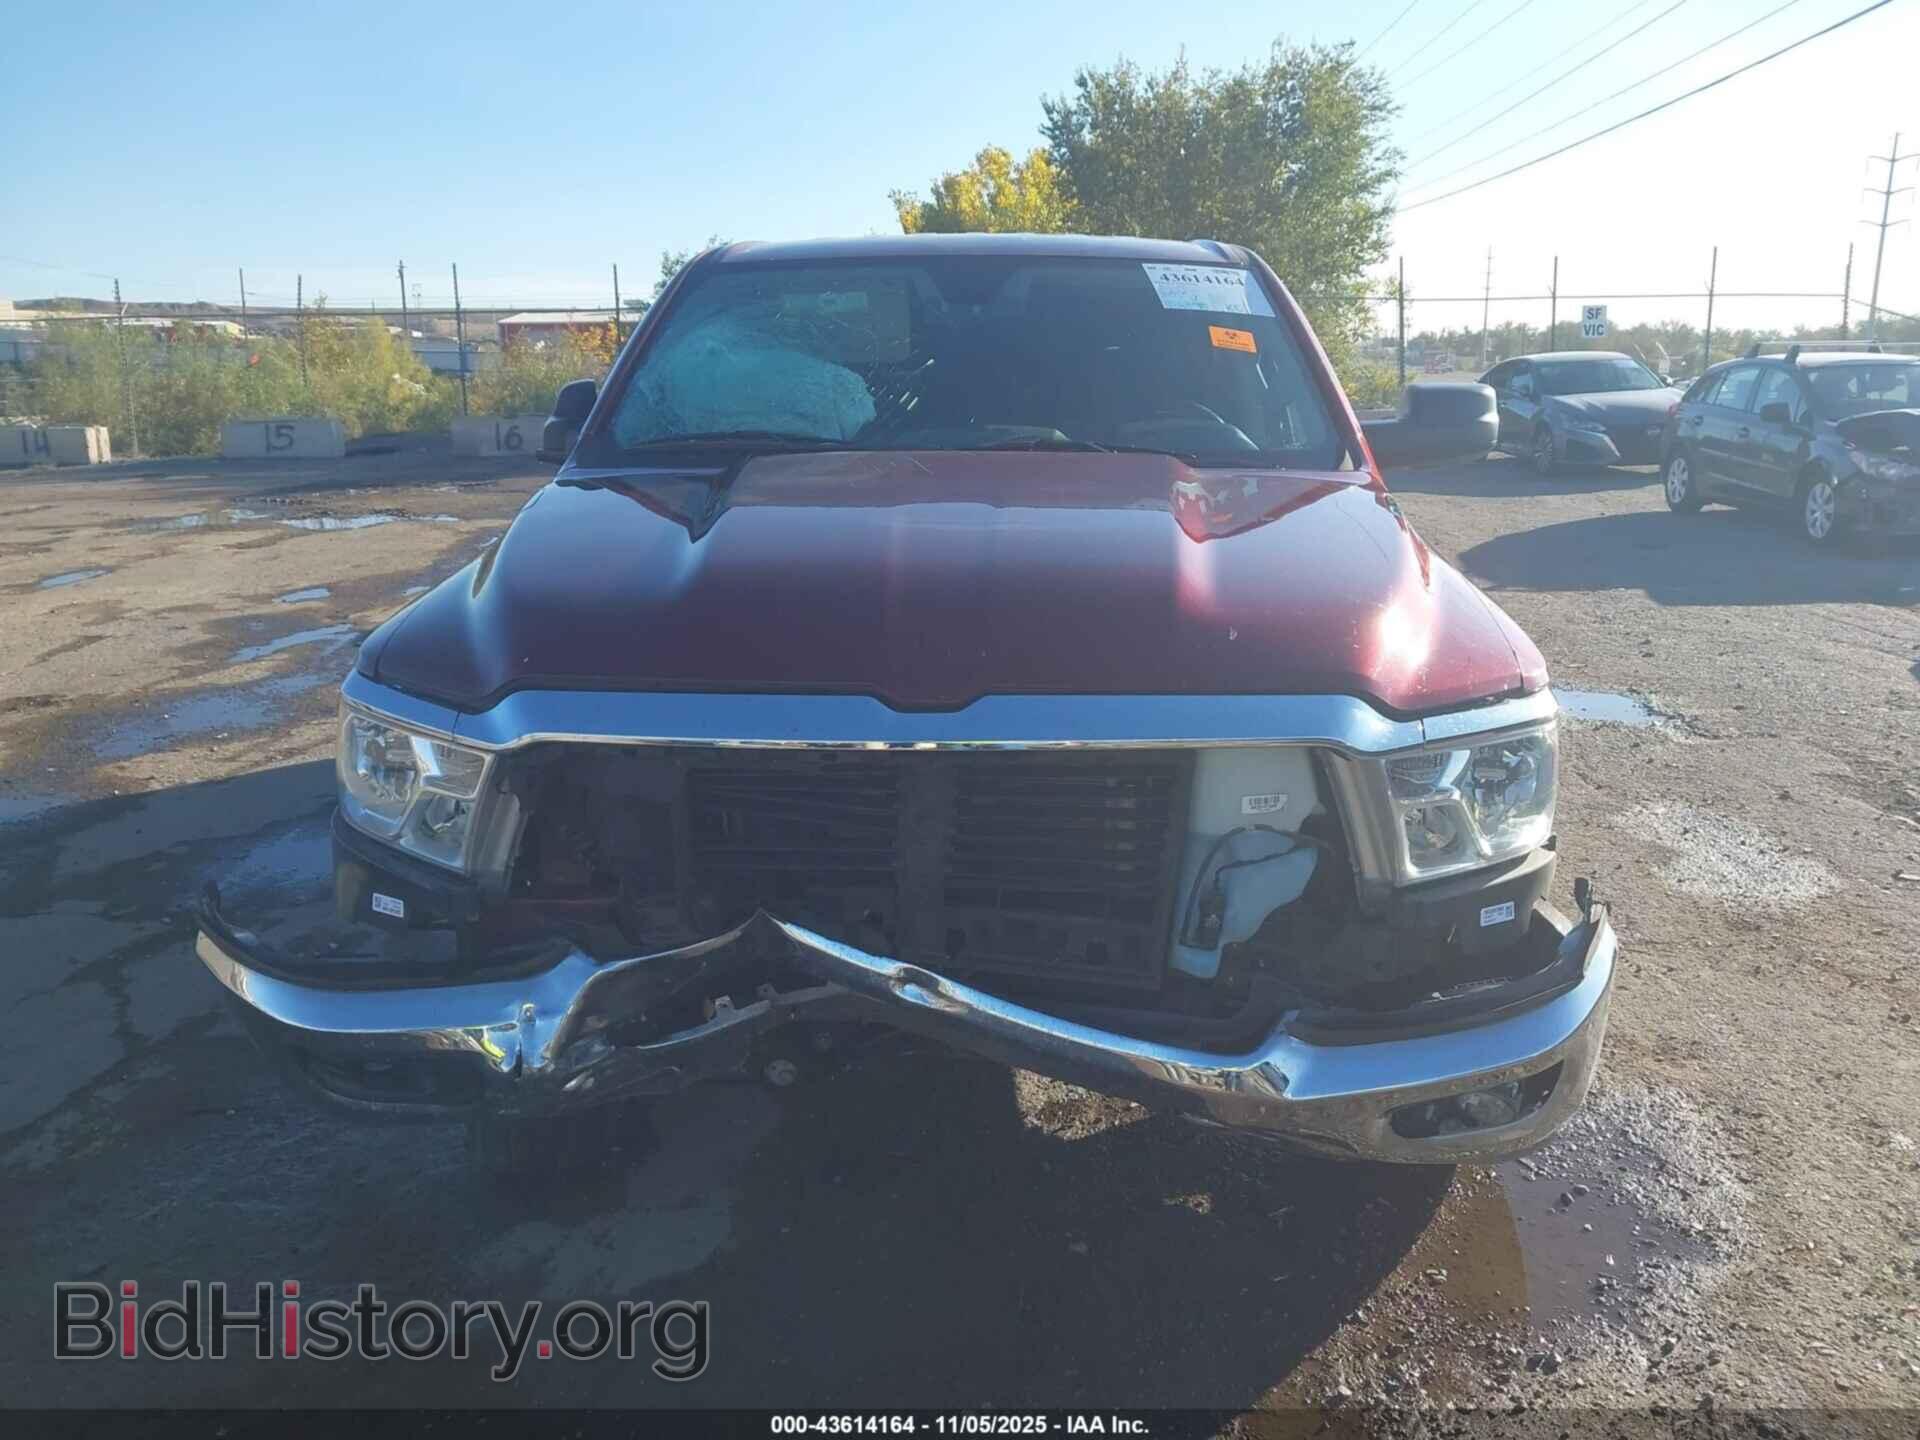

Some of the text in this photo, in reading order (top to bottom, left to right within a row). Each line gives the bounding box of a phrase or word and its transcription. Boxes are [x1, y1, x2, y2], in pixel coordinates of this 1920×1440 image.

[1159, 273, 1245, 287] 43614164
[1586, 307, 1602, 320] SF
[1584, 323, 1604, 336] VIC
[264, 423, 295, 454] 15
[496, 423, 523, 451] 16
